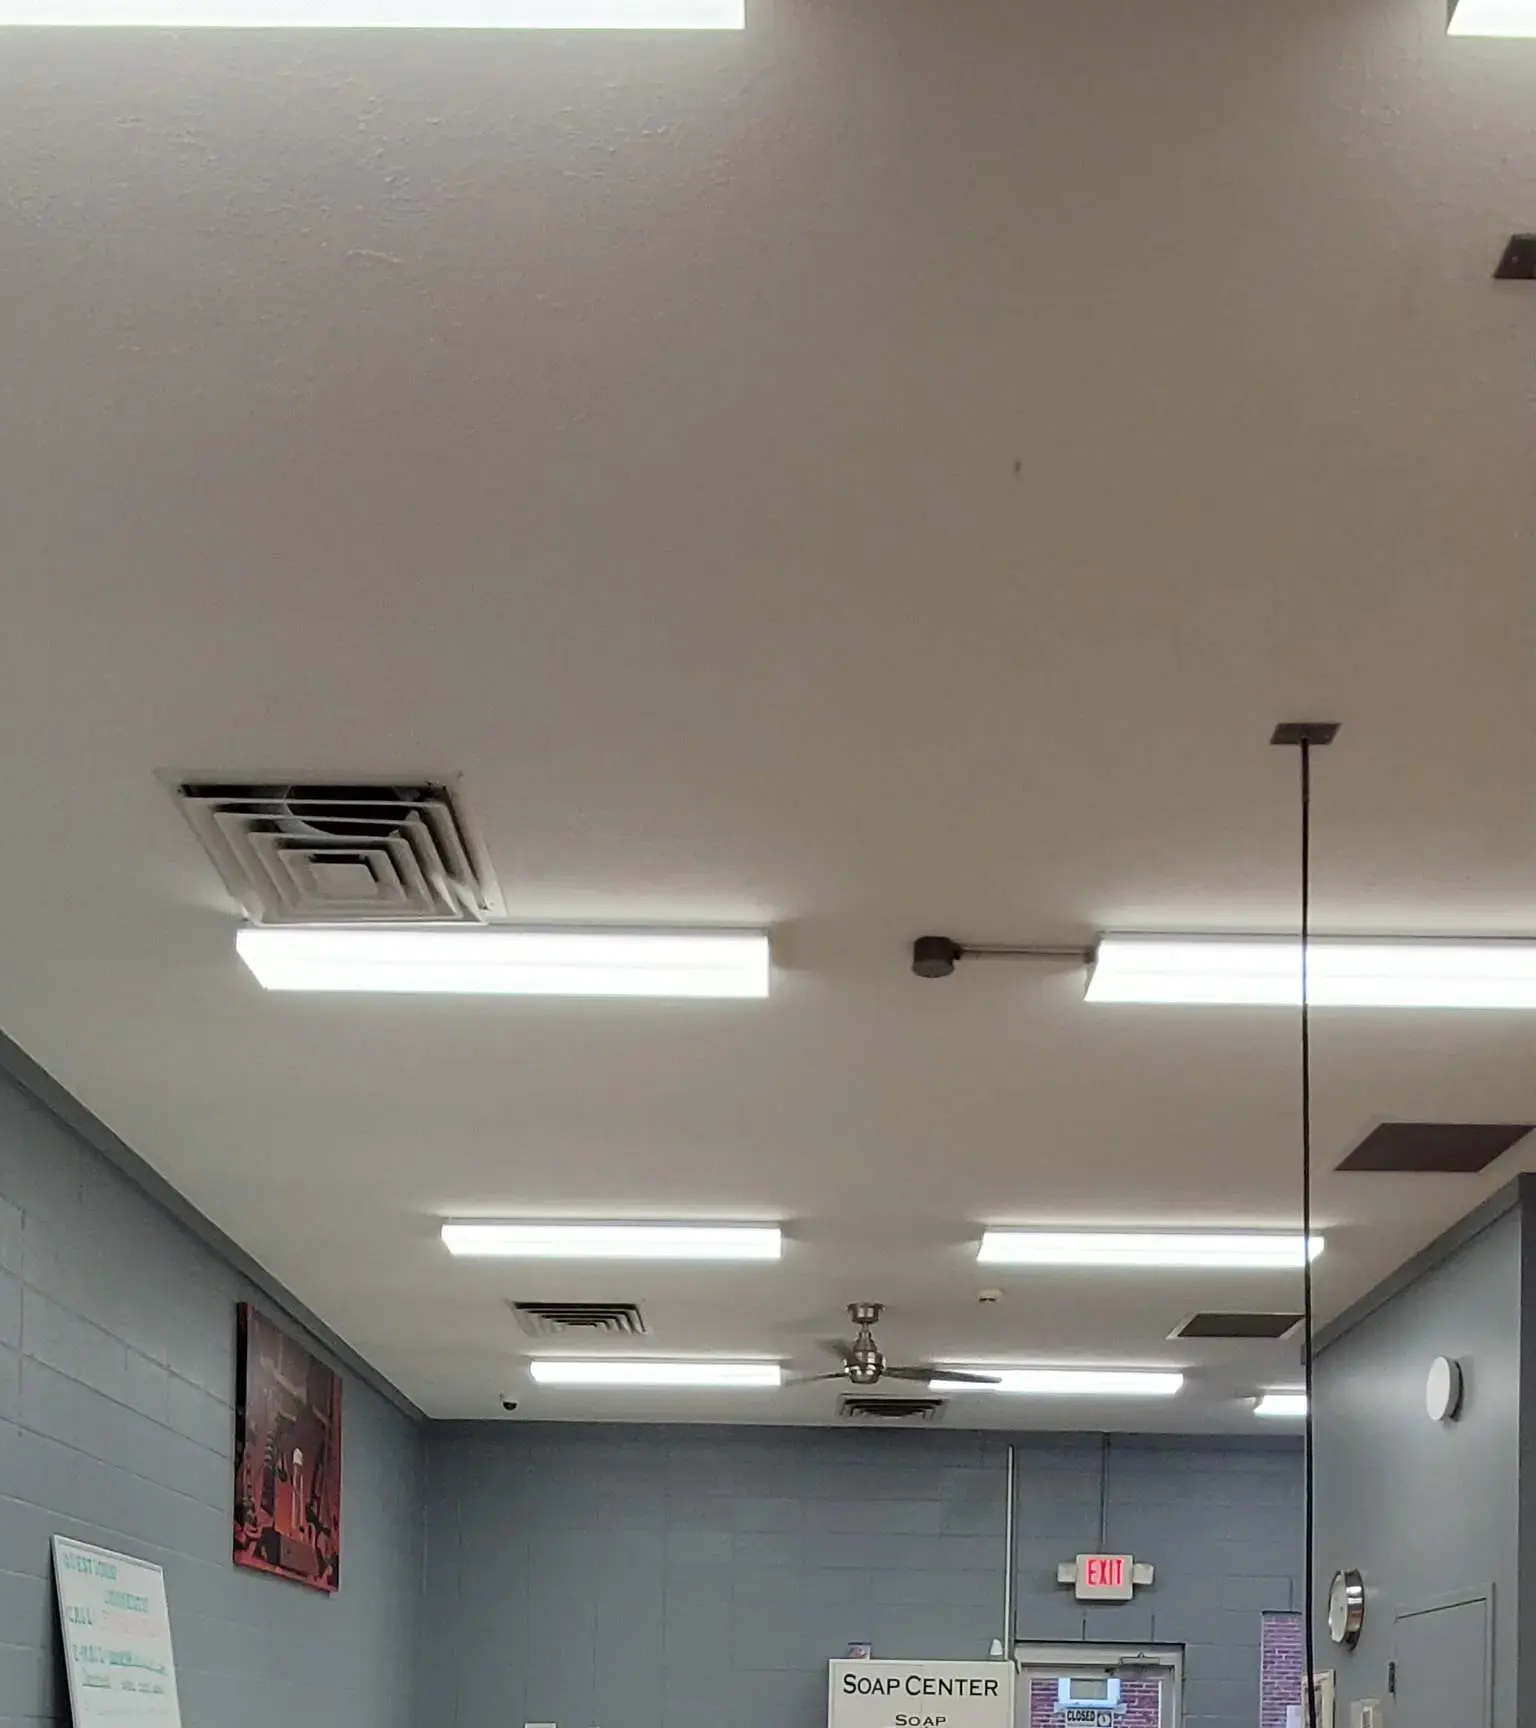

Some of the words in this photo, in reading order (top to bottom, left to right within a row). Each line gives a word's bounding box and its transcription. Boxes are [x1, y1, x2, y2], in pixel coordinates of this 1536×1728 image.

[1087, 1559, 1123, 1586] EXIT
[843, 1673, 900, 1695] SOAP
[905, 1675, 999, 1696] CENTER
[895, 1713, 947, 1727] SOAP
[1066, 1710, 1096, 1722] CLOSED
